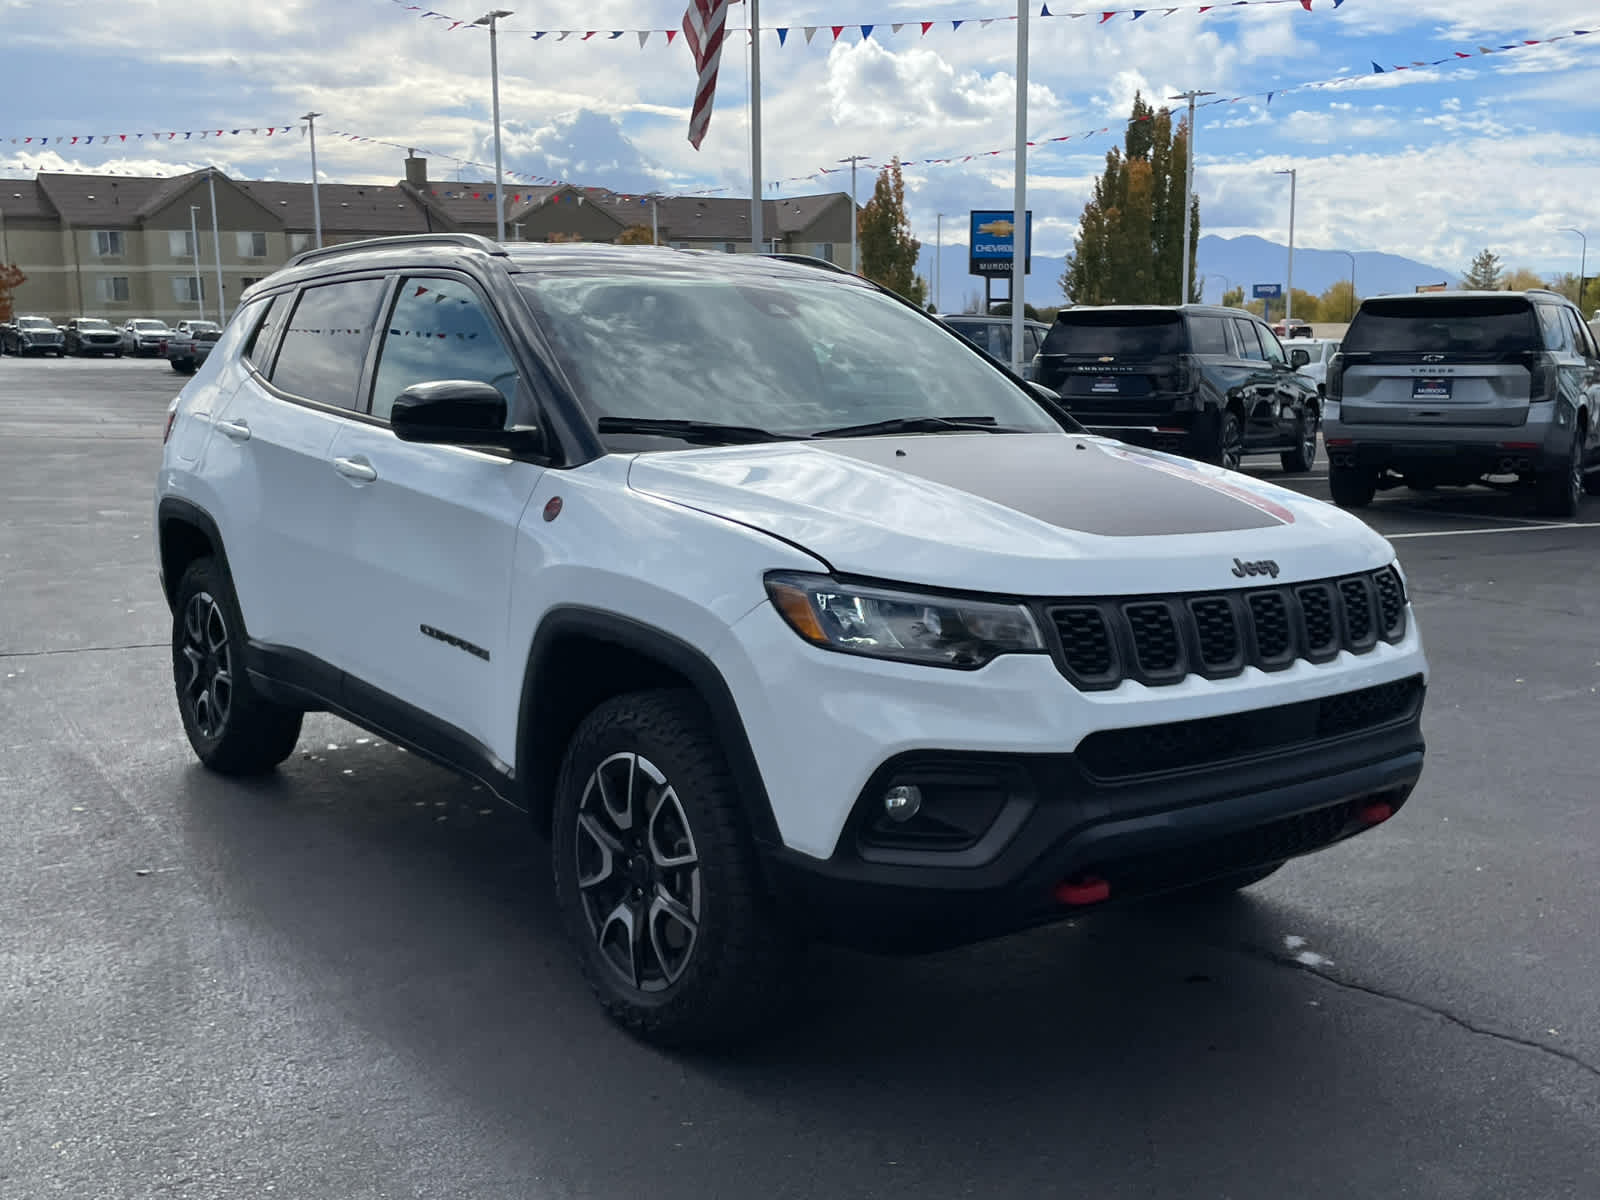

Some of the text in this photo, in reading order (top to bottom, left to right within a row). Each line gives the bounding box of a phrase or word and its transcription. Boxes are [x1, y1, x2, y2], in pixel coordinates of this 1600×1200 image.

[975, 244, 1015, 253] CHEVROL
[979, 263, 1015, 271] MURDOC
[1231, 557, 1280, 579] Jeep
